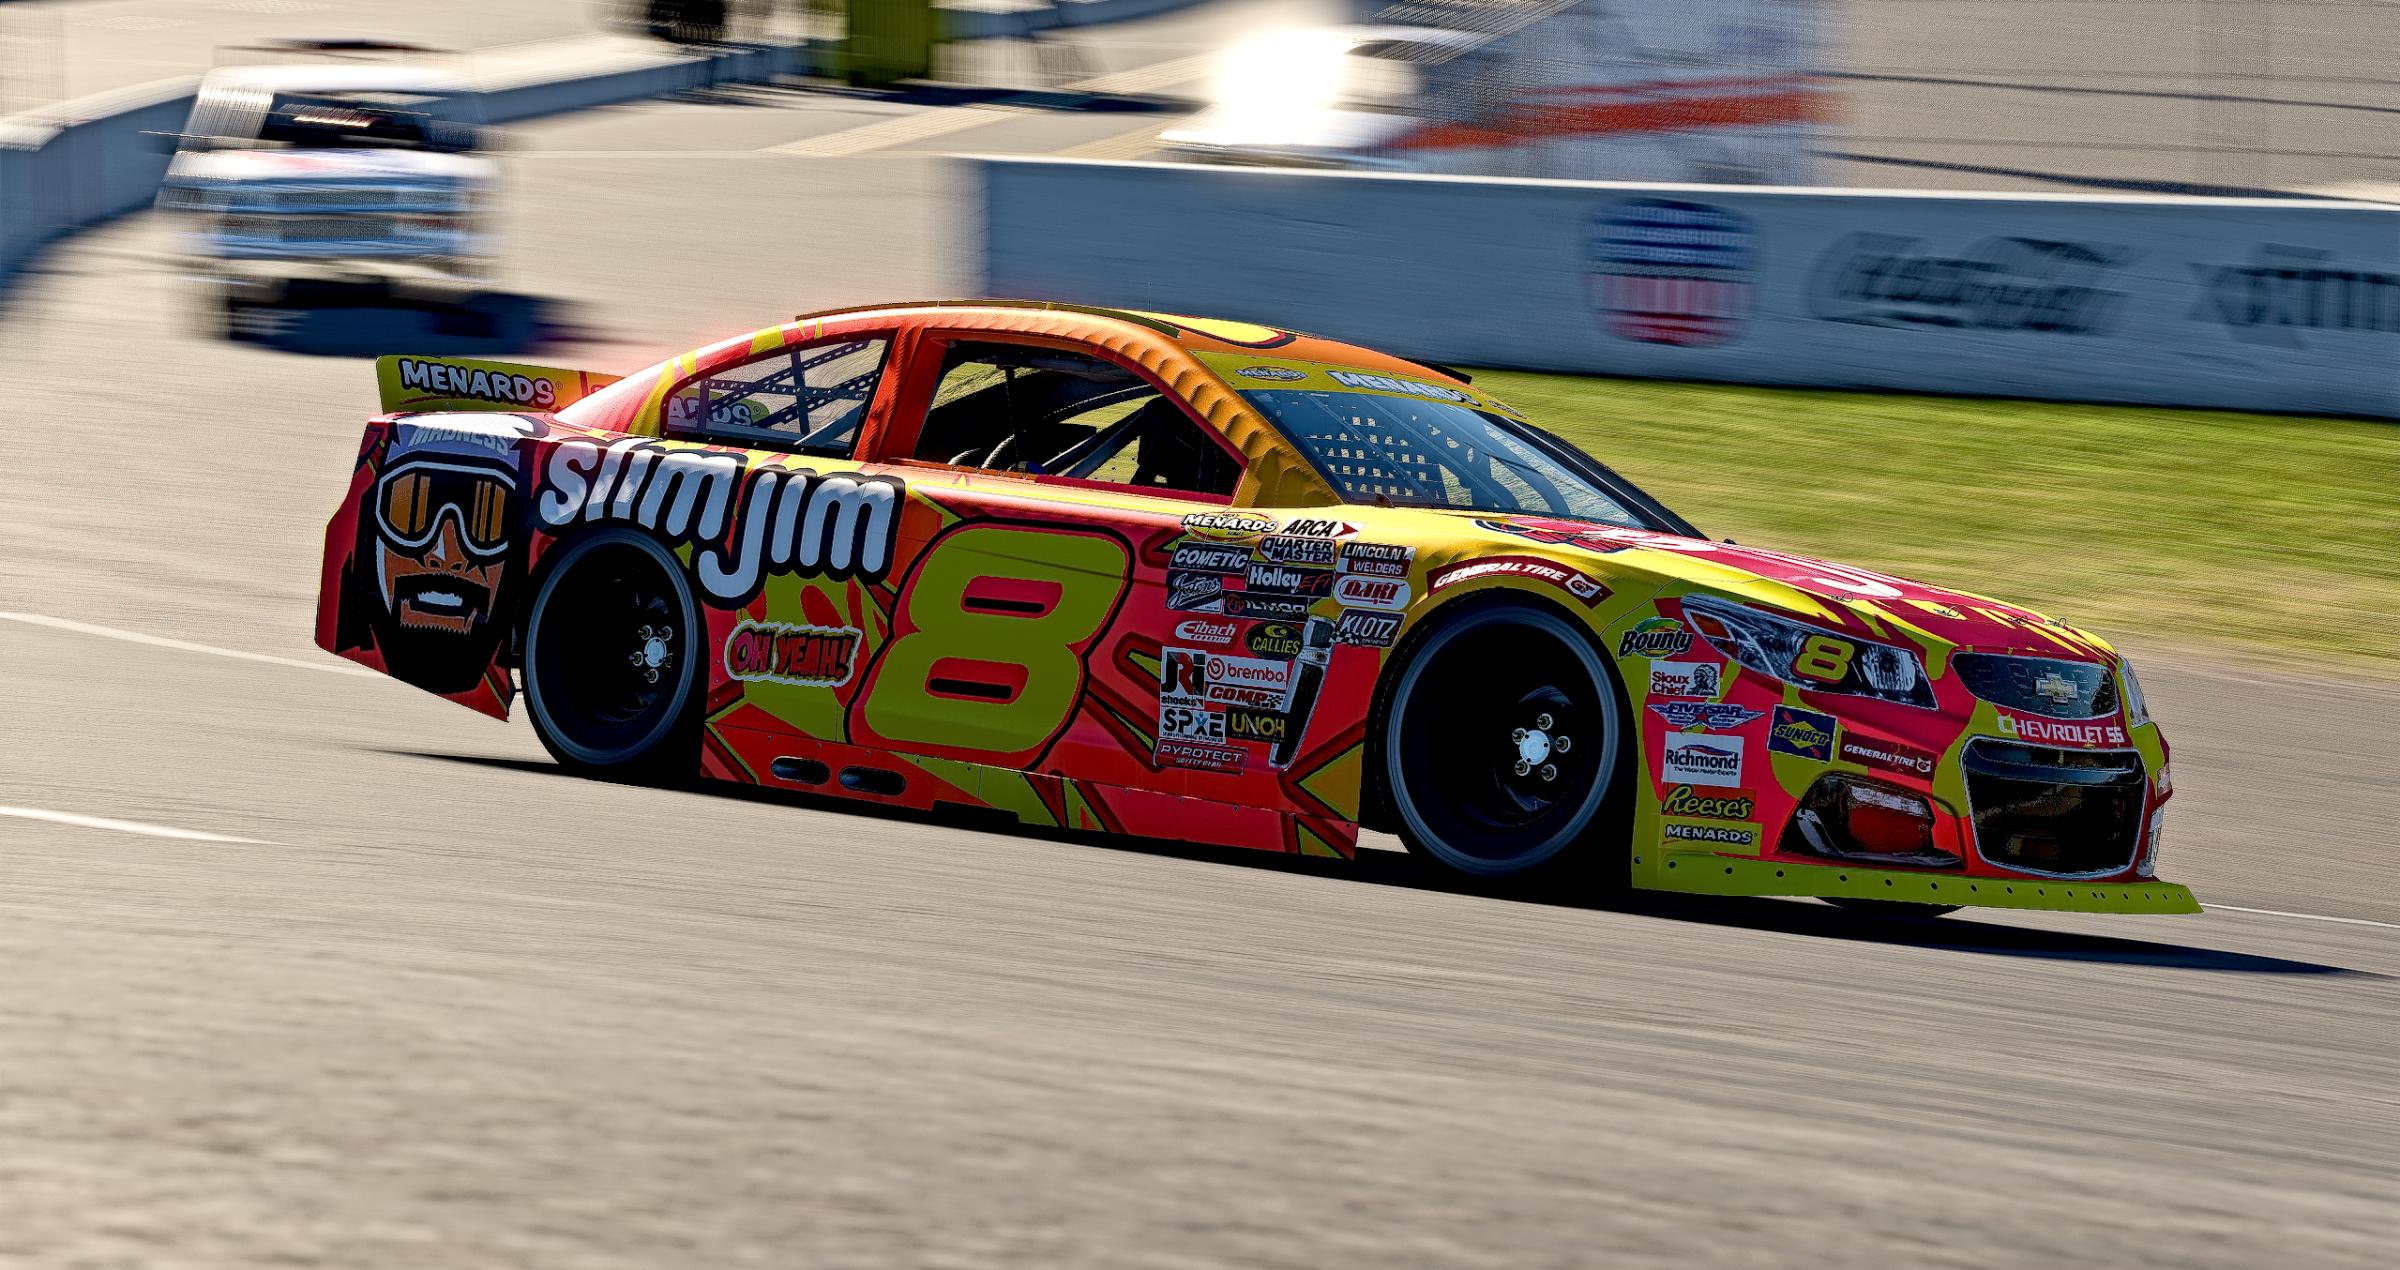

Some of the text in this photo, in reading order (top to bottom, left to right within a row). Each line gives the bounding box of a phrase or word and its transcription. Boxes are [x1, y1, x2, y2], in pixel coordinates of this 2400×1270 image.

[1182, 514, 1278, 534] MENARDS
[1281, 520, 1337, 537] ARCA
[1262, 537, 1333, 553] QUARTER
[1344, 545, 1402, 560] LINCOLN
[1174, 549, 1249, 569] COMETIC
[1271, 550, 1333, 563] MASTER
[1353, 561, 1403, 575] WELDERS
[1434, 562, 1520, 589] GENERAL
[1522, 563, 1568, 581] TIRE
[1250, 566, 1302, 593] Holley
[1175, 619, 1237, 644] Eibach
[1340, 615, 1398, 639] KLOTZ
[865, 527, 1126, 753] 8
[1252, 636, 1301, 655] CALLIES
[1618, 628, 1694, 658] Bounty
[730, 630, 858, 679] OH YEAH!
[1797, 635, 1855, 683] 8
[1652, 671, 1690, 685] Sioux
[1209, 686, 1269, 704] COMP
[1652, 682, 1686, 696] Chief
[1161, 694, 1197, 707] shocks
[1668, 703, 1743, 716] FIVE STAR
[1231, 712, 1285, 739] UNOH
[1774, 724, 1830, 746] SUNOCO
[1998, 715, 2102, 743] CHEVROLET
[1161, 744, 1242, 762] PYROTECT
[1666, 749, 1739, 769] Richmond
[1844, 744, 1892, 762] GENERAL
[1893, 754, 1917, 768] TIRE
[1662, 784, 1753, 818] Reese's
[1666, 825, 1753, 845] MENARDS
